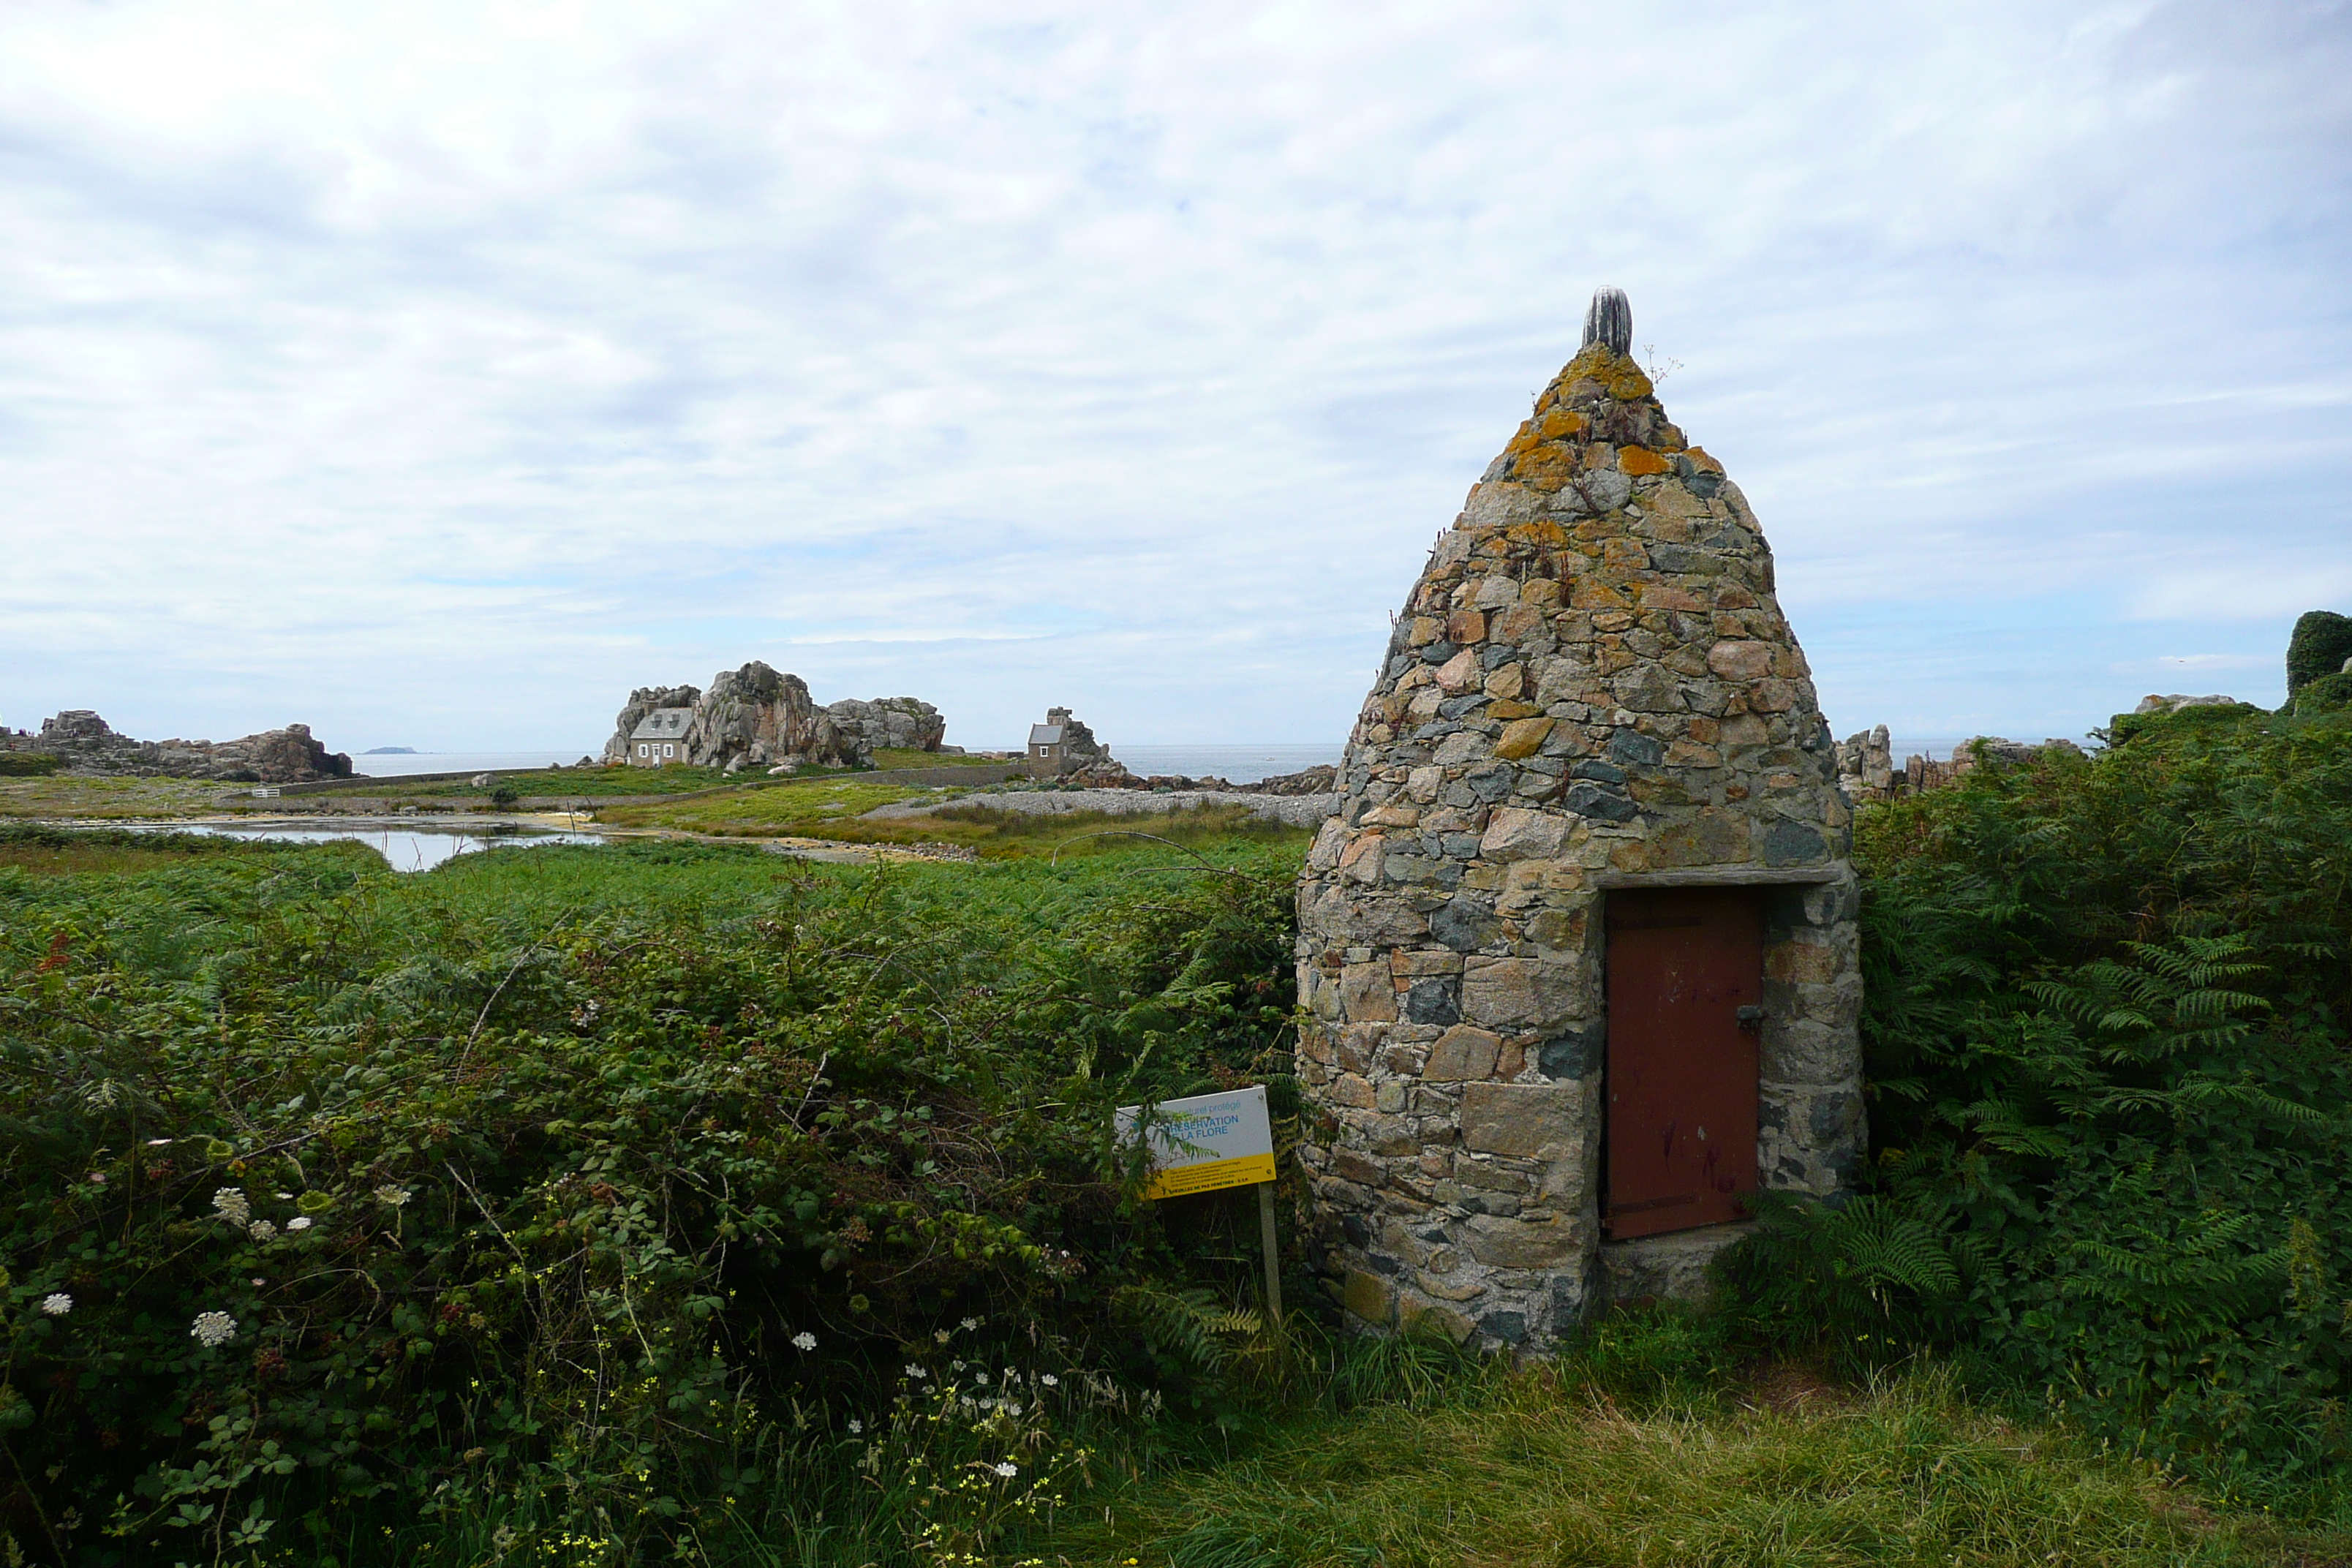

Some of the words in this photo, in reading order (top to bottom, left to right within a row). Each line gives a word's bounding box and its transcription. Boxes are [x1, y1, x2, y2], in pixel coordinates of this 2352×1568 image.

[1209, 1100, 1241, 1114] protégé
[1182, 1131, 1194, 1141] LA
[1196, 1126, 1229, 1138] FLORE
